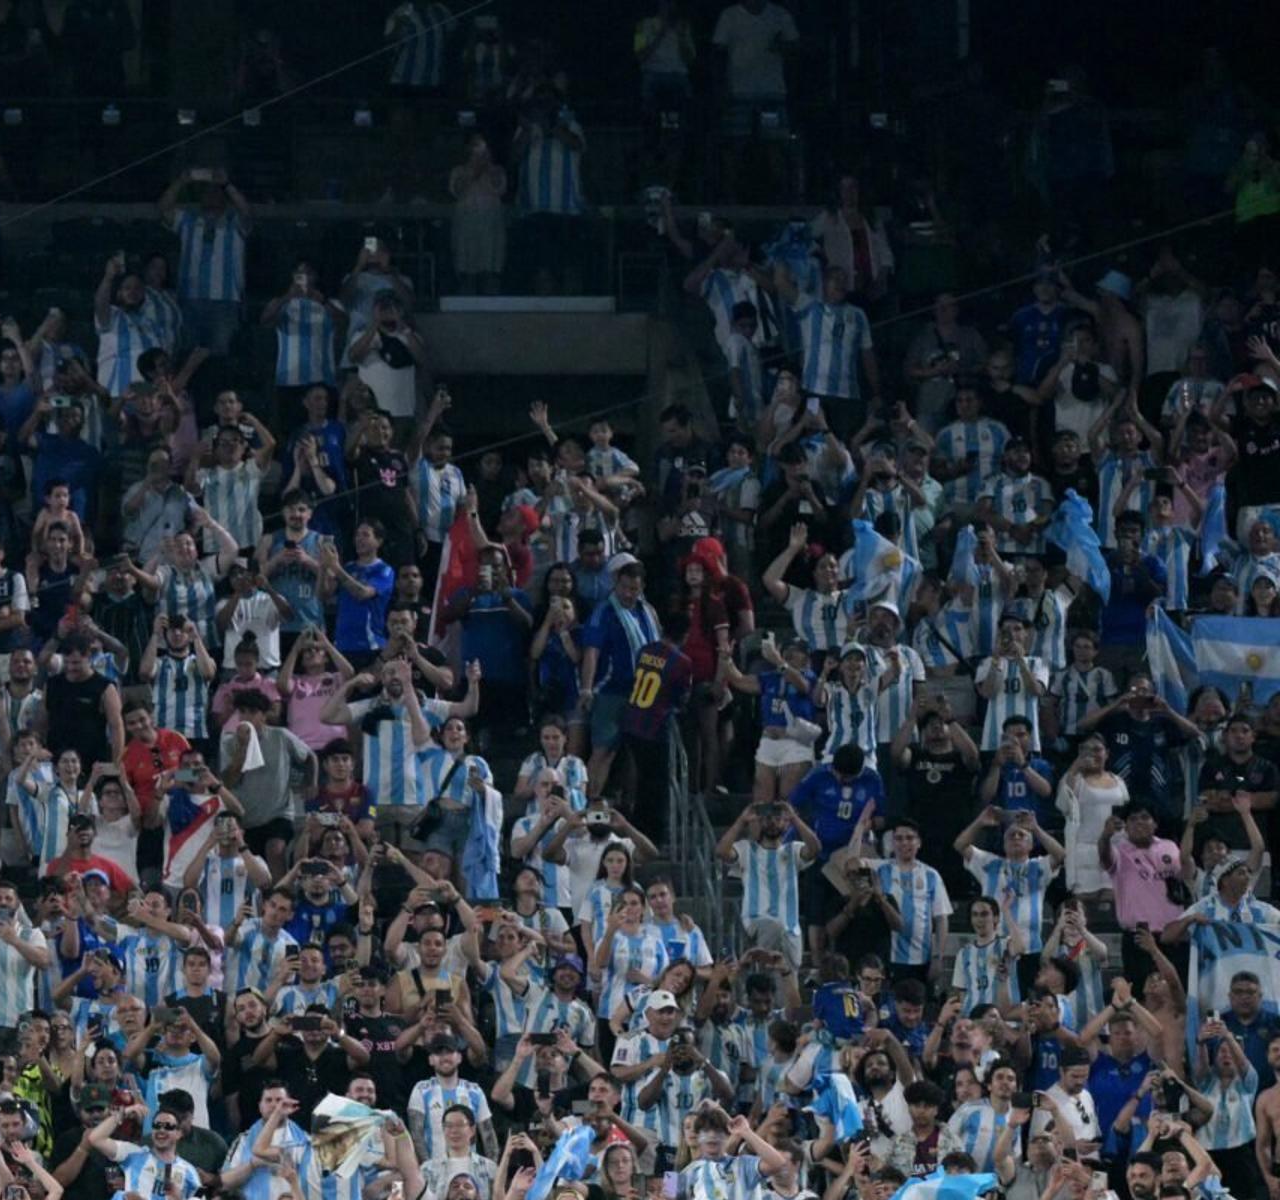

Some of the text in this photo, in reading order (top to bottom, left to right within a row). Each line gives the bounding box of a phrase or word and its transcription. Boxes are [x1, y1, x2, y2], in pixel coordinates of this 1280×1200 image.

[298, 585, 311, 598] 10
[630, 668, 661, 710] 10
[1117, 733, 1129, 745] 10
[1008, 782, 1026, 798] 10
[838, 802, 852, 819] 10
[376, 1041, 396, 1050] XBT
[1043, 1051, 1057, 1069] 10
